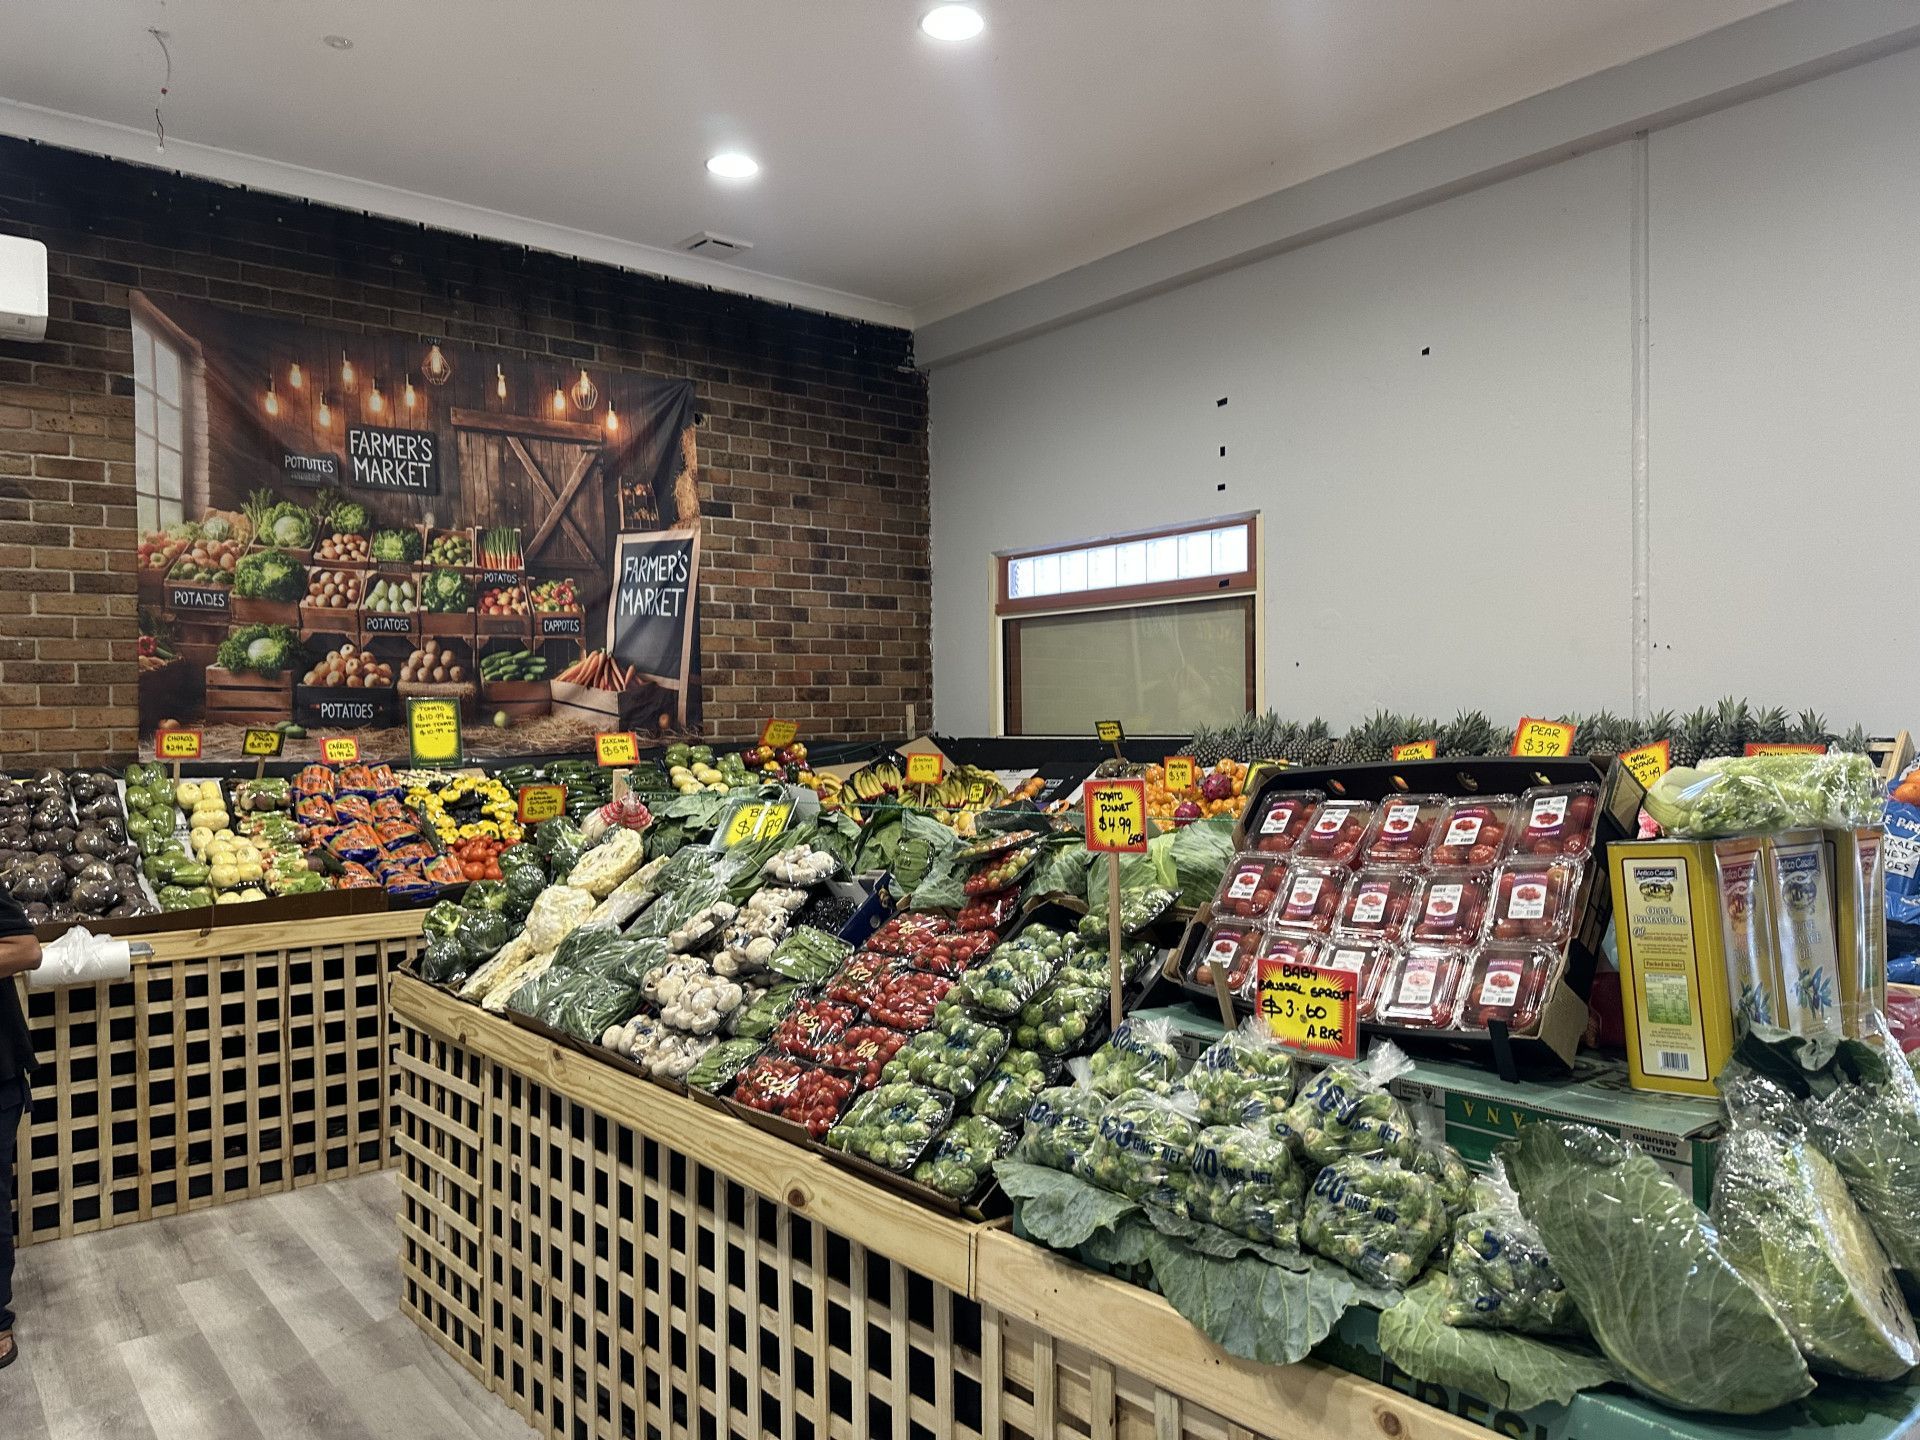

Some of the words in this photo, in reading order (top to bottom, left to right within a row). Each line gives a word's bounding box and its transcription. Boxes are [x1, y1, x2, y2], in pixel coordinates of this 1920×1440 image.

[350, 430, 432, 462] FARMER'S
[354, 456, 431, 488] MARKET
[623, 550, 688, 582] FARMER'S
[484, 572, 518, 584] POTATOS
[620, 588, 684, 618] MARKET
[321, 702, 374, 718] POTATOES
[1530, 725, 1560, 738] PEAR
[1628, 756, 1658, 772] ORANGE
[1094, 791, 1123, 802] TOMATO
[1100, 802, 1133, 815] PUNNET
[1099, 815, 1131, 835] $4.99
[1283, 964, 1317, 980] BABY
[1258, 979, 1305, 995] BRUSSEL
[1310, 987, 1354, 1001] SPROUT
[1262, 994, 1327, 1019] $3.60
[1307, 1024, 1316, 1038] A
[1320, 1026, 1343, 1042] BAG
[1378, 1124, 1402, 1144] NET
[1632, 1133, 1677, 1148] ASSURED
[1131, 1137, 1158, 1157] GMS
[1162, 1148, 1184, 1165] NET
[1373, 1206, 1398, 1224] NET
